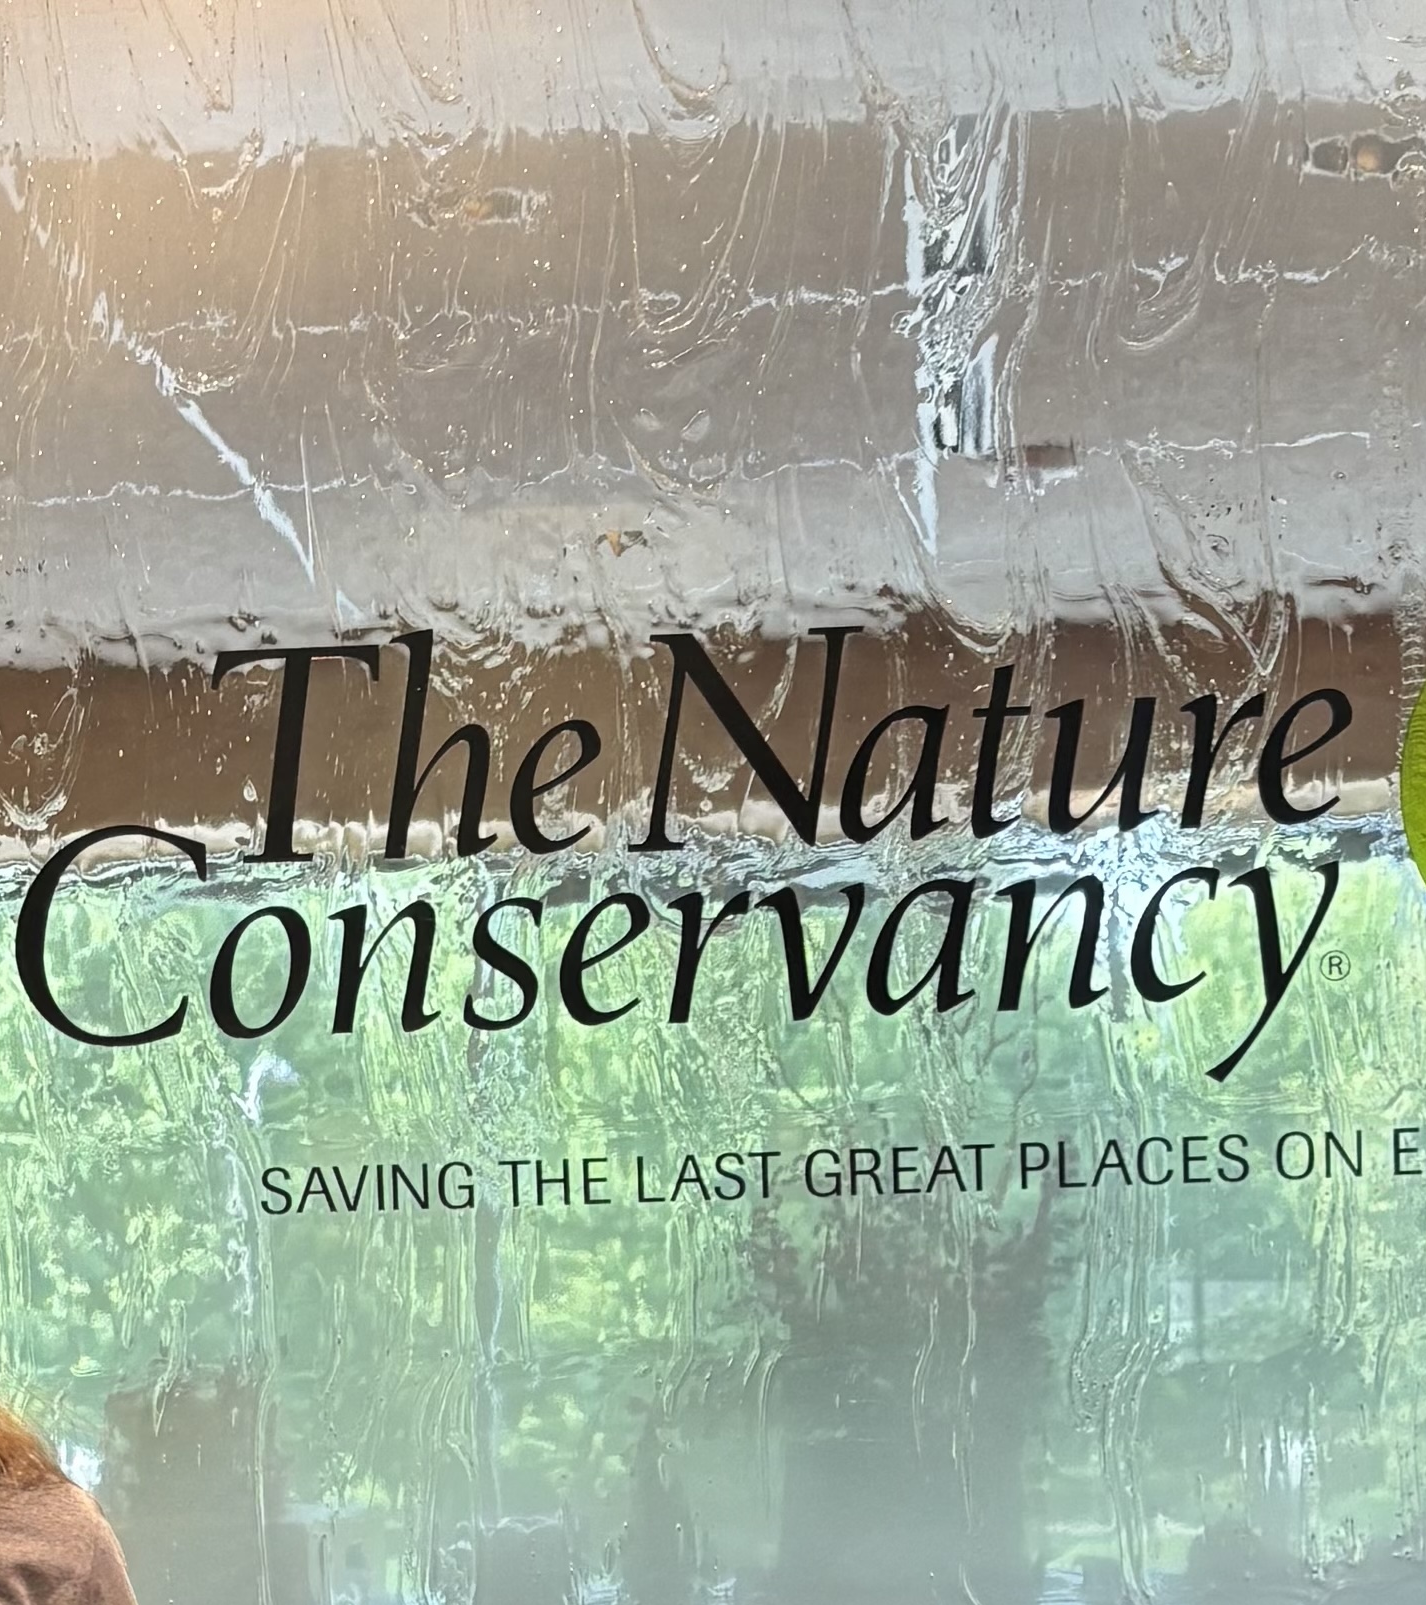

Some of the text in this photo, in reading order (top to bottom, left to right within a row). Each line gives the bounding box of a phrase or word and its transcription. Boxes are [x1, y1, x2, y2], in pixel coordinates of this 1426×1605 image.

[211, 625, 1353, 863] The Nature
[15, 824, 1339, 1082] Conservancy
[261, 1161, 475, 1215] SAVING
[498, 1157, 611, 1207] THE
[637, 1151, 781, 1203] LAST
[804, 1143, 995, 1198] GREAT
[1020, 1134, 1250, 1190] PLACES
[1276, 1130, 1363, 1180] ON
